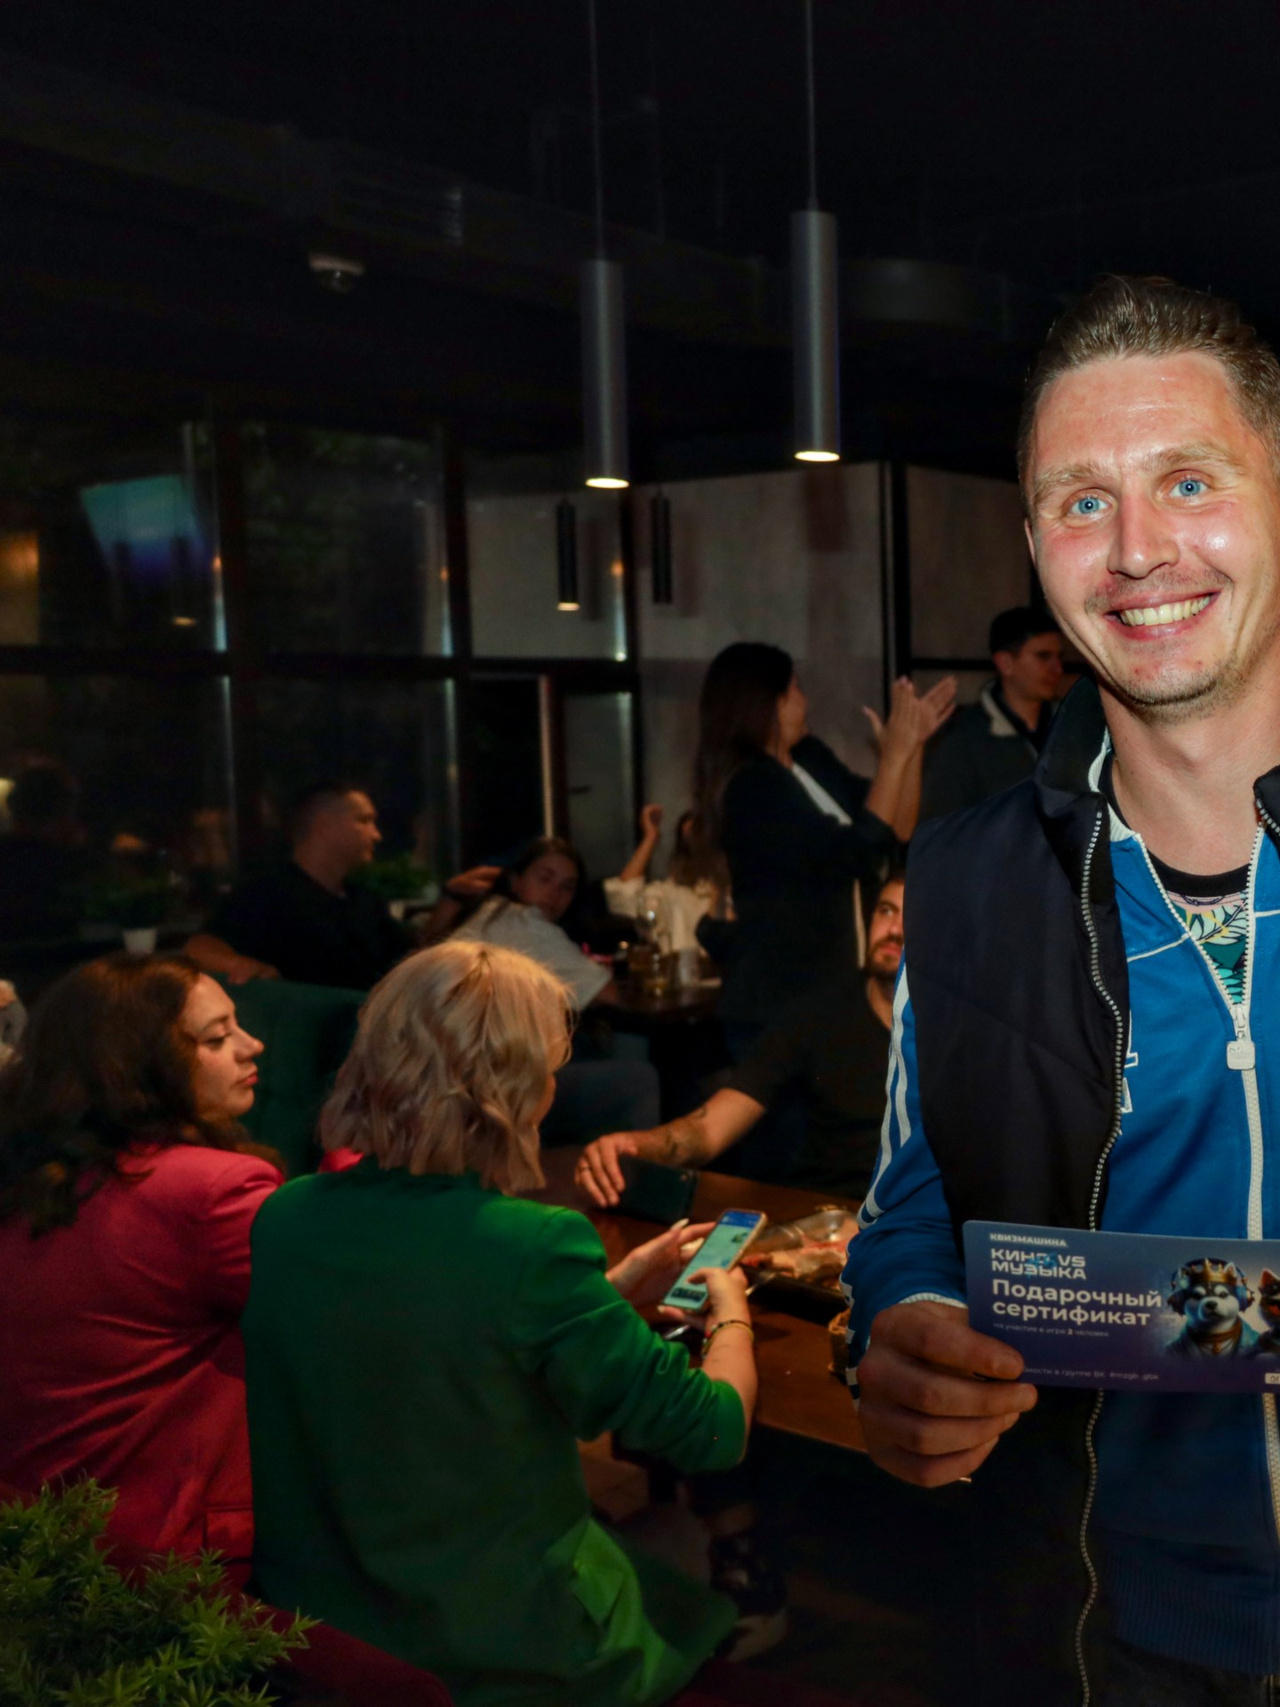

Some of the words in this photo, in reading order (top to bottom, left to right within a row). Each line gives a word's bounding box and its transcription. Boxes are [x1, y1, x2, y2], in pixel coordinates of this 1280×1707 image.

[989, 1233, 1068, 1247] КВИЗМАШИНА
[990, 1248, 1051, 1263] КИНО
[1057, 1254, 1087, 1268] VS
[991, 1260, 1087, 1280] МУЗЫКА
[992, 1278, 1163, 1308] Подарочный
[992, 1301, 1151, 1326] сертификат
[1067, 1328, 1073, 1336] 2
